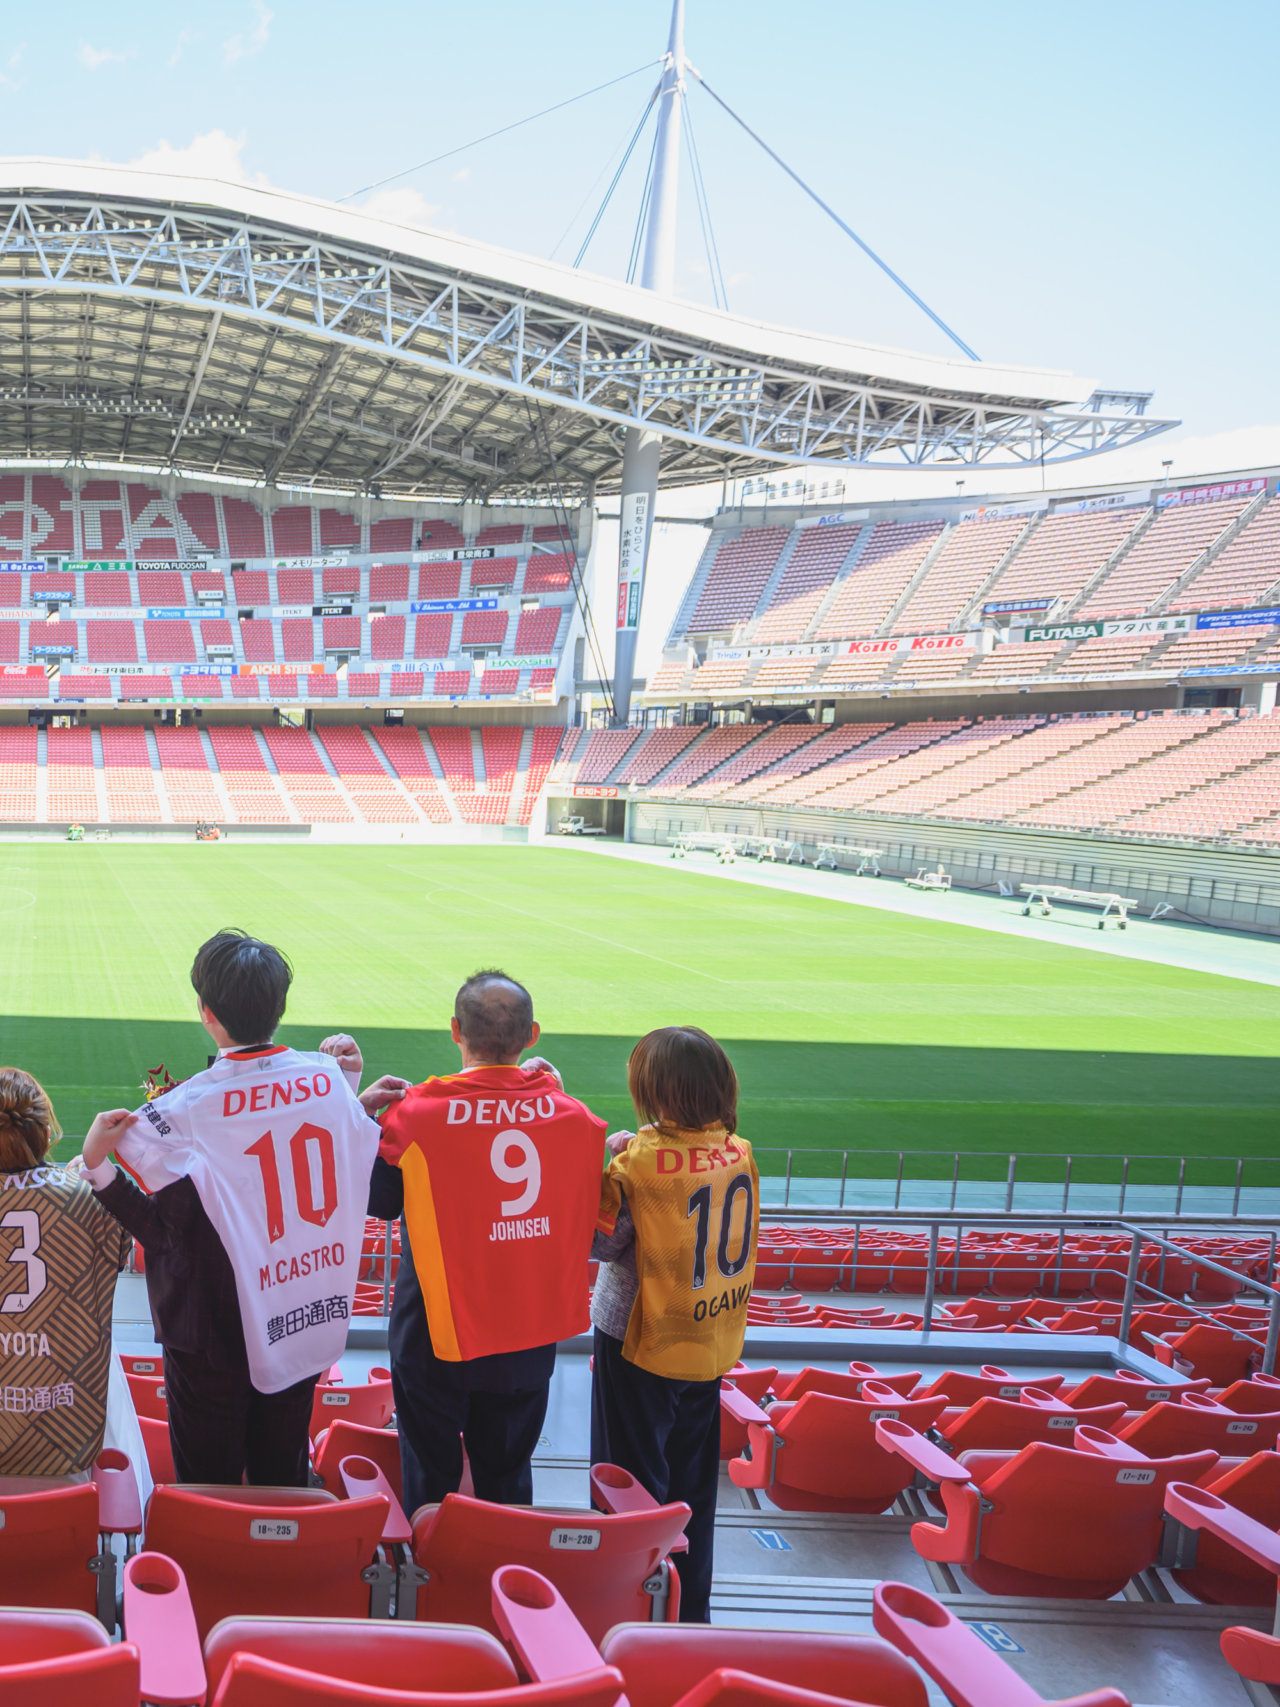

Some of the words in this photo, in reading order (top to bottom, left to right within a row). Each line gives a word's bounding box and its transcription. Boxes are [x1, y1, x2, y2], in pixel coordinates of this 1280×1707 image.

[633, 495, 647, 554] 明日をひらく
[818, 513, 845, 525] AGC
[621, 528, 633, 568] 水素社会
[108, 562, 126, 570] 三五
[137, 562, 170, 570] TOYOTA
[170, 561, 206, 570] FUDOSAN
[291, 558, 343, 568] メモリーターフ
[321, 608, 343, 616] JTEKT
[1028, 625, 1098, 640] FUTABA
[1108, 618, 1187, 634] フタバ産業
[747, 645, 832, 658] トリニティ工業
[94, 666, 144, 674] トヨタ東日本
[250, 665, 281, 674] AICHI
[284, 665, 314, 674] STEEL
[492, 658, 553, 667] HAYASHI
[223, 1073, 333, 1117] DENSO
[446, 1095, 555, 1125] DENSO
[243, 1122, 339, 1244] 10
[489, 1129, 542, 1217] 9
[488, 1216, 551, 1243] JOHNSEN
[686, 1173, 754, 1290] 10
[259, 1242, 346, 1291] M.CASTRO
[266, 1294, 349, 1347] 豊田通商
[750, 1530, 784, 1550] 17
[966, 1623, 1020, 1651] 18
